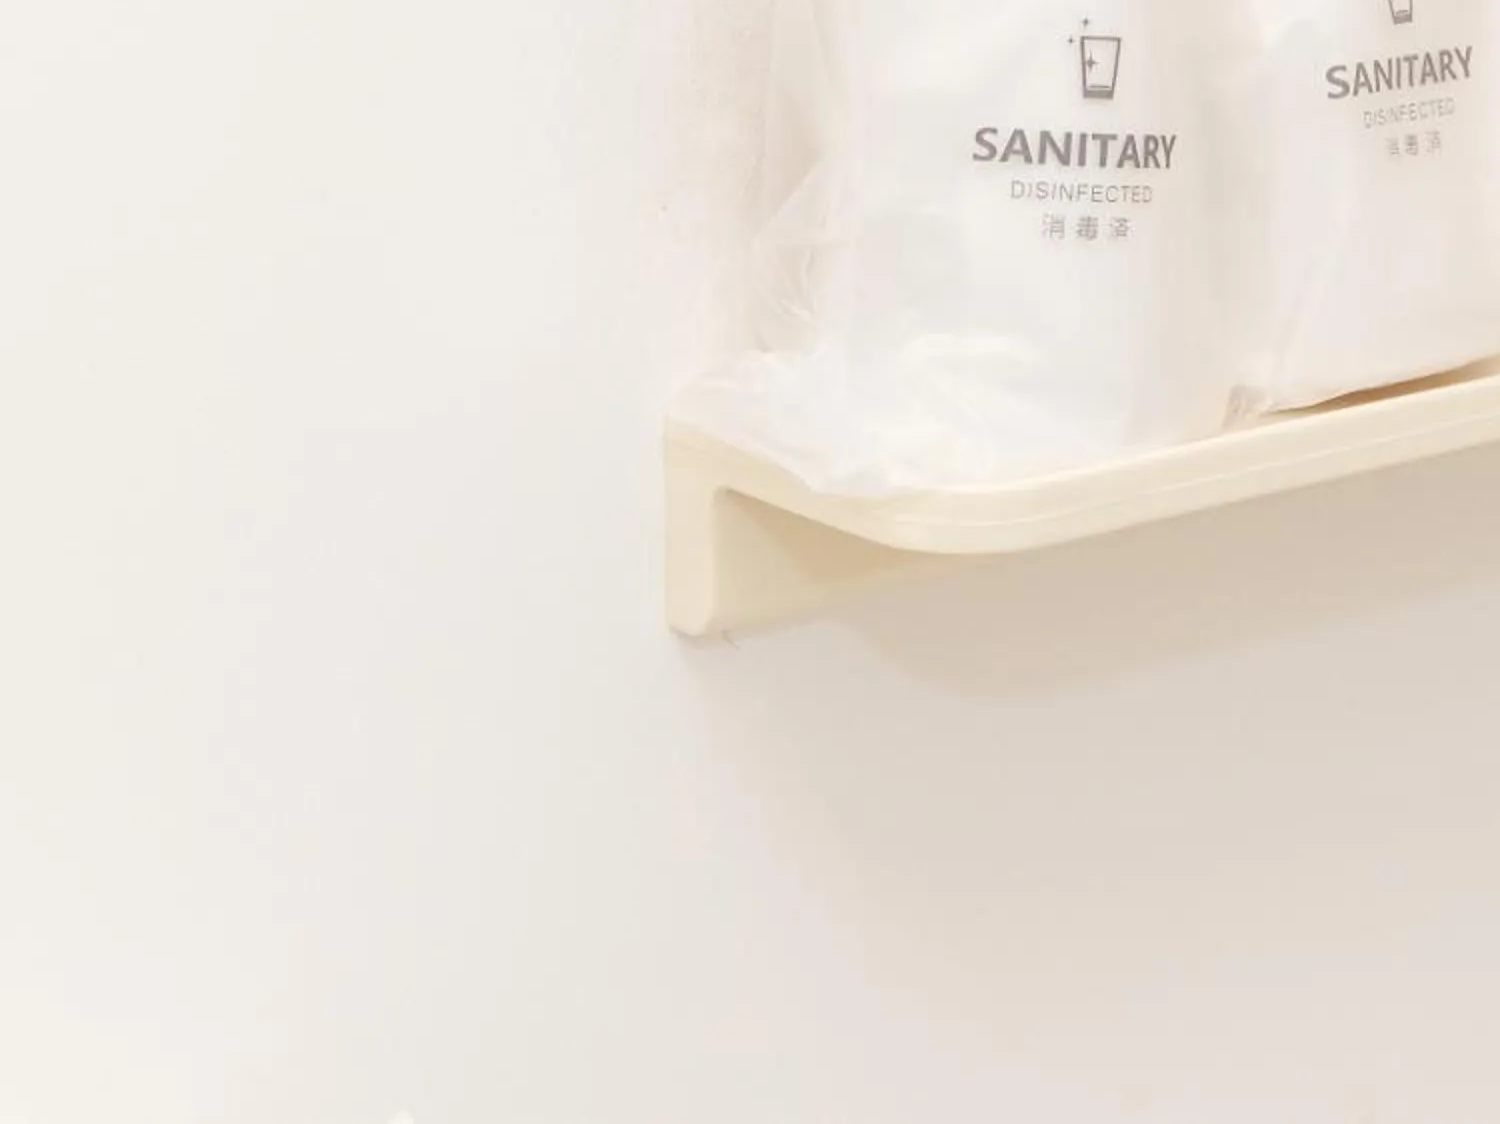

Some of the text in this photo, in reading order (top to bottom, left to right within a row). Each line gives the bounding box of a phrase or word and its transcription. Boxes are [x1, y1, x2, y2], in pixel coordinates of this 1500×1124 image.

[1325, 45, 1473, 99] SANITARY
[1363, 97, 1455, 129] DISINFECTED
[972, 126, 1177, 170] SANITARY
[1010, 179, 1154, 204] DISINFECTED
[1041, 213, 1132, 241] 消毒済
